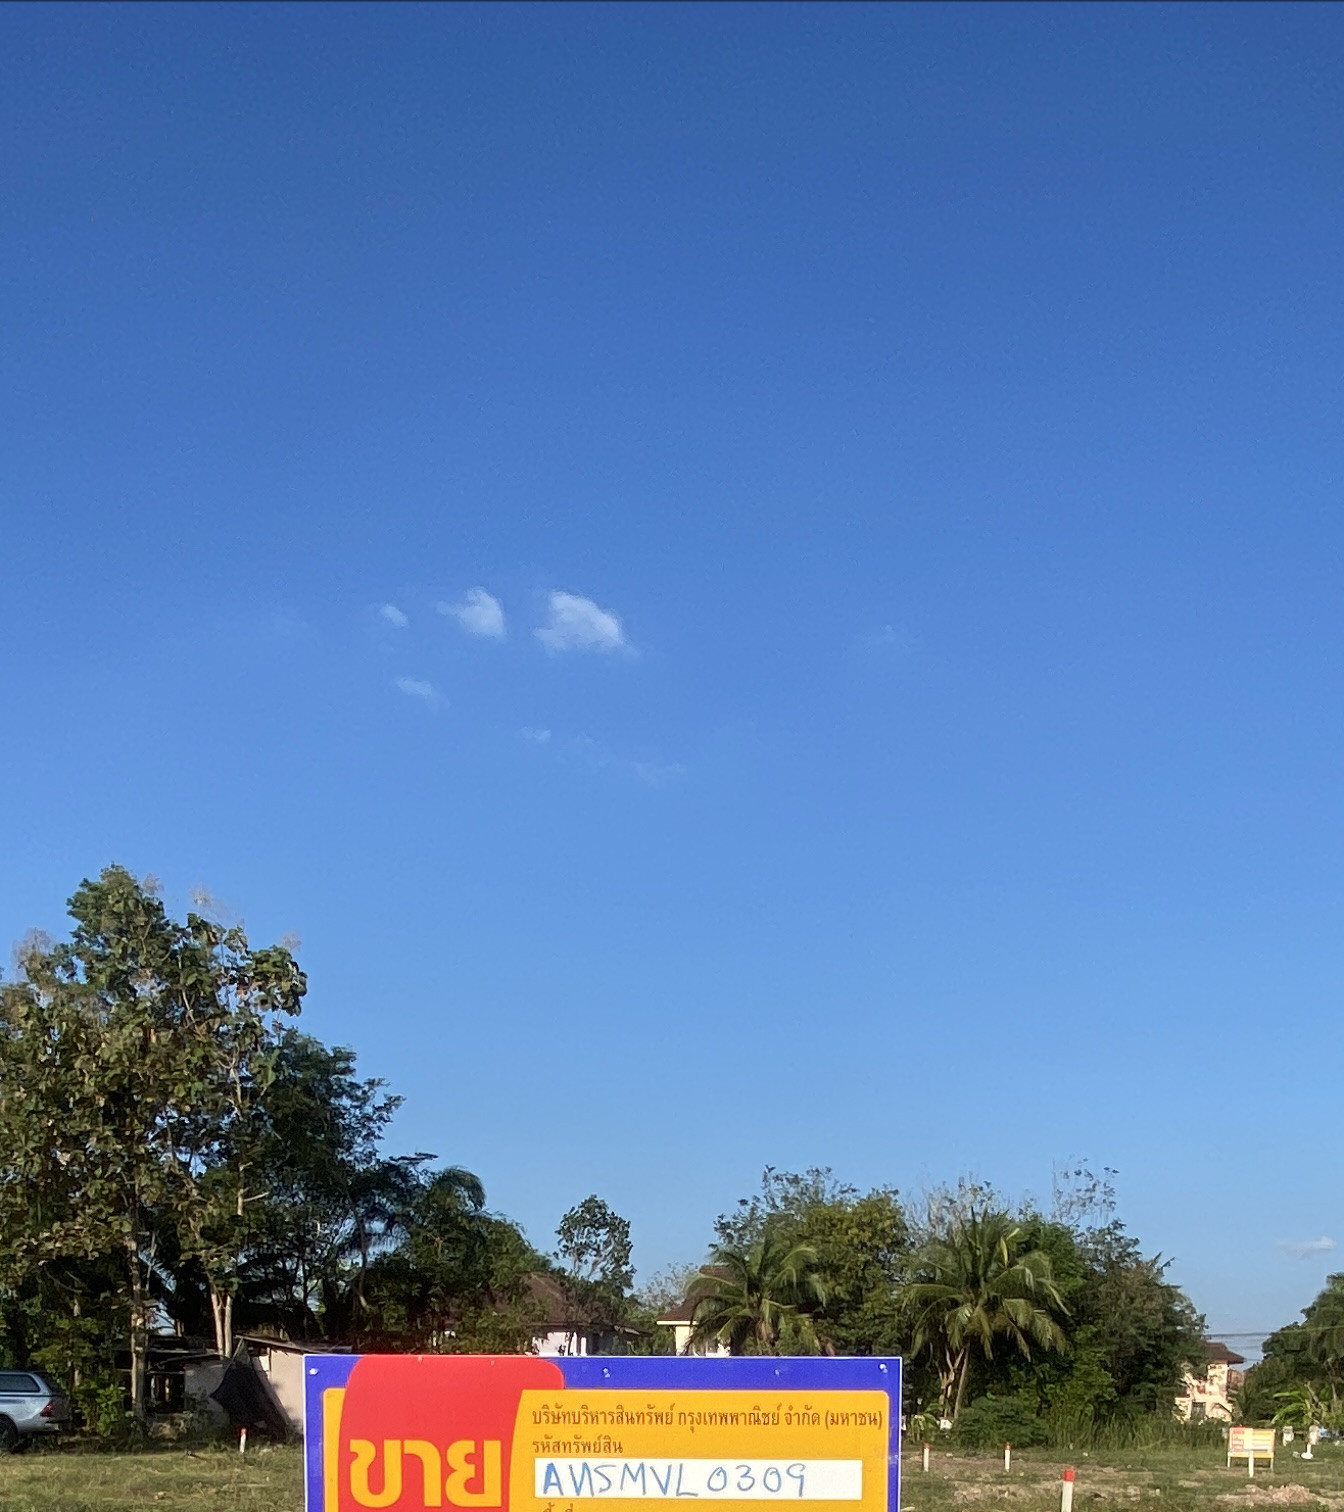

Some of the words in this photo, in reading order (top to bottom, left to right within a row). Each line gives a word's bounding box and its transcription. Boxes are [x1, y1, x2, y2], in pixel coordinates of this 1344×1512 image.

[532, 1402, 675, 1426] บริษัทบริหารสินทรัพย์
[677, 1402, 782, 1433] กรุงเทพพาณิชย์
[784, 1404, 821, 1427] จำกัด
[824, 1410, 883, 1430] (มหาชน)
[531, 1433, 624, 1454] รหัสทรัพย์สิน
[349, 1439, 502, 1508] ขาย
